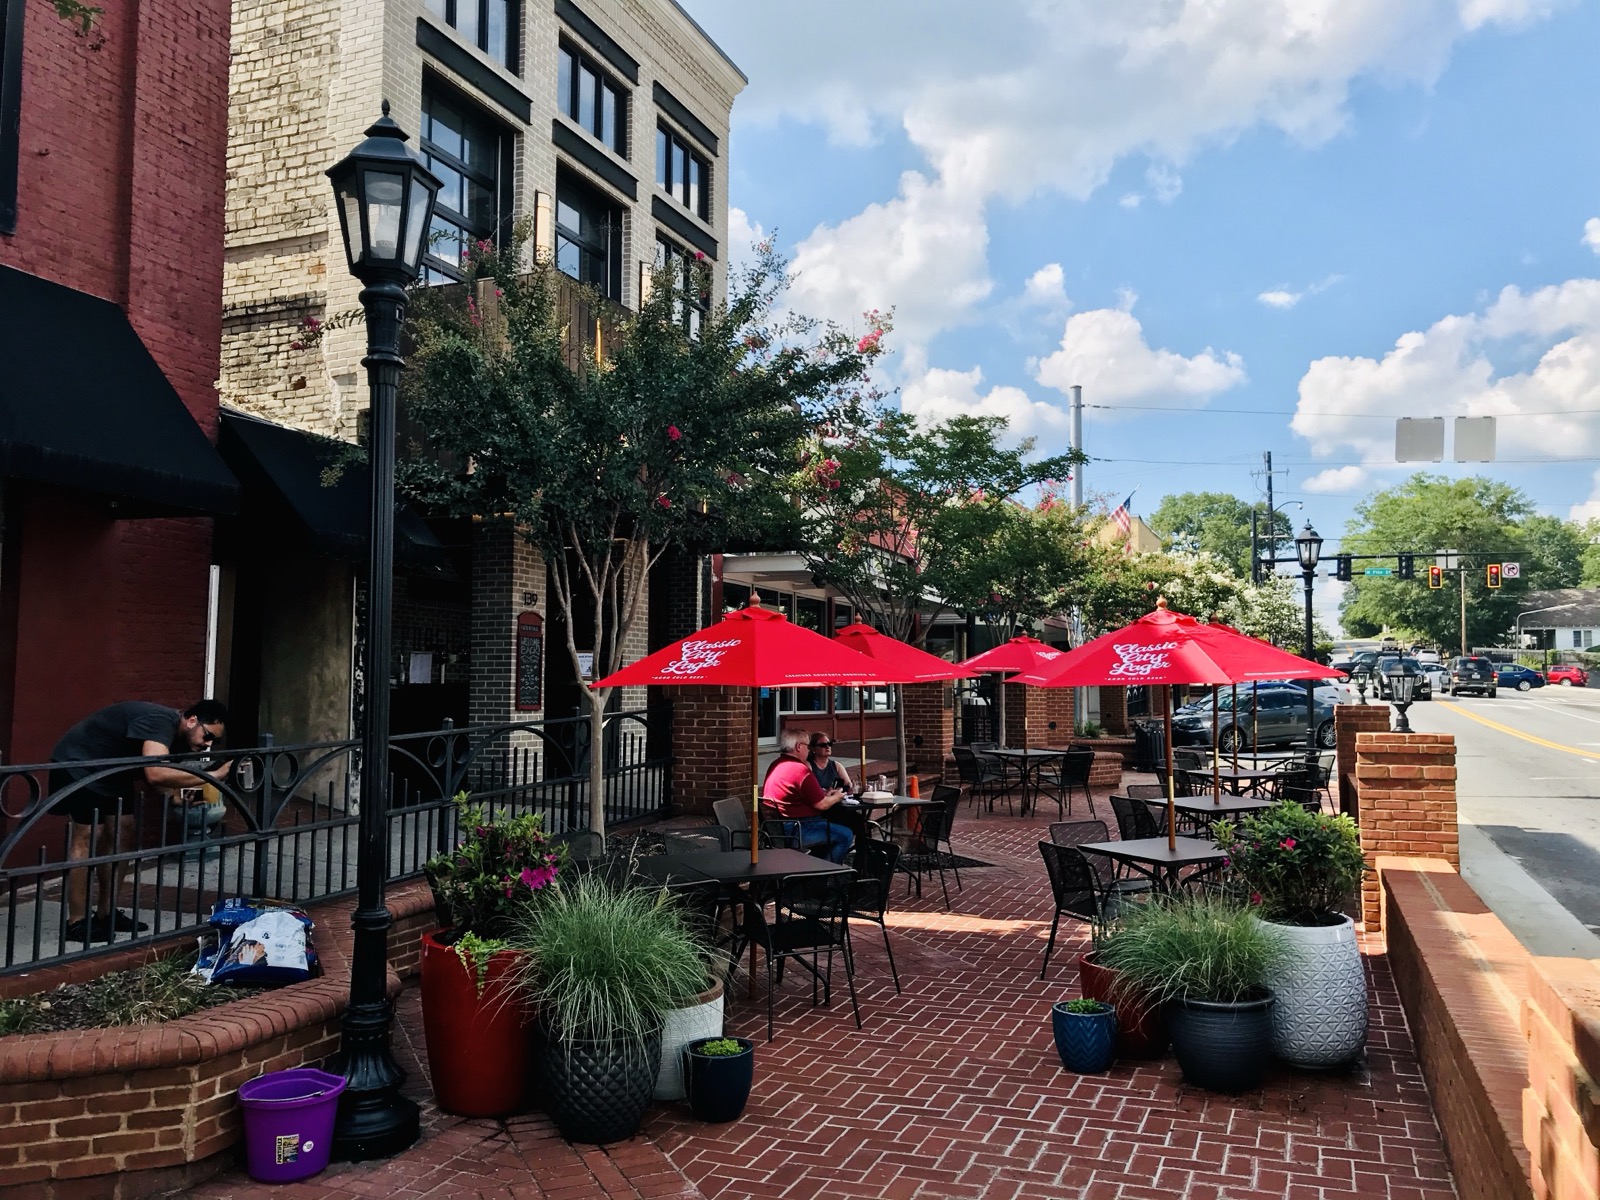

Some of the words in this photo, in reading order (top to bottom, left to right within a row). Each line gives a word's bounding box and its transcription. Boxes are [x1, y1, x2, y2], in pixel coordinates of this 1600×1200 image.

[524, 592, 538, 606] 139
[682, 638, 742, 652] Classic
[1112, 642, 1178, 654] Classic
[681, 650, 728, 662] City
[1120, 652, 1170, 664] City
[660, 659, 721, 674] Lager
[1108, 661, 1172, 676] Lager
